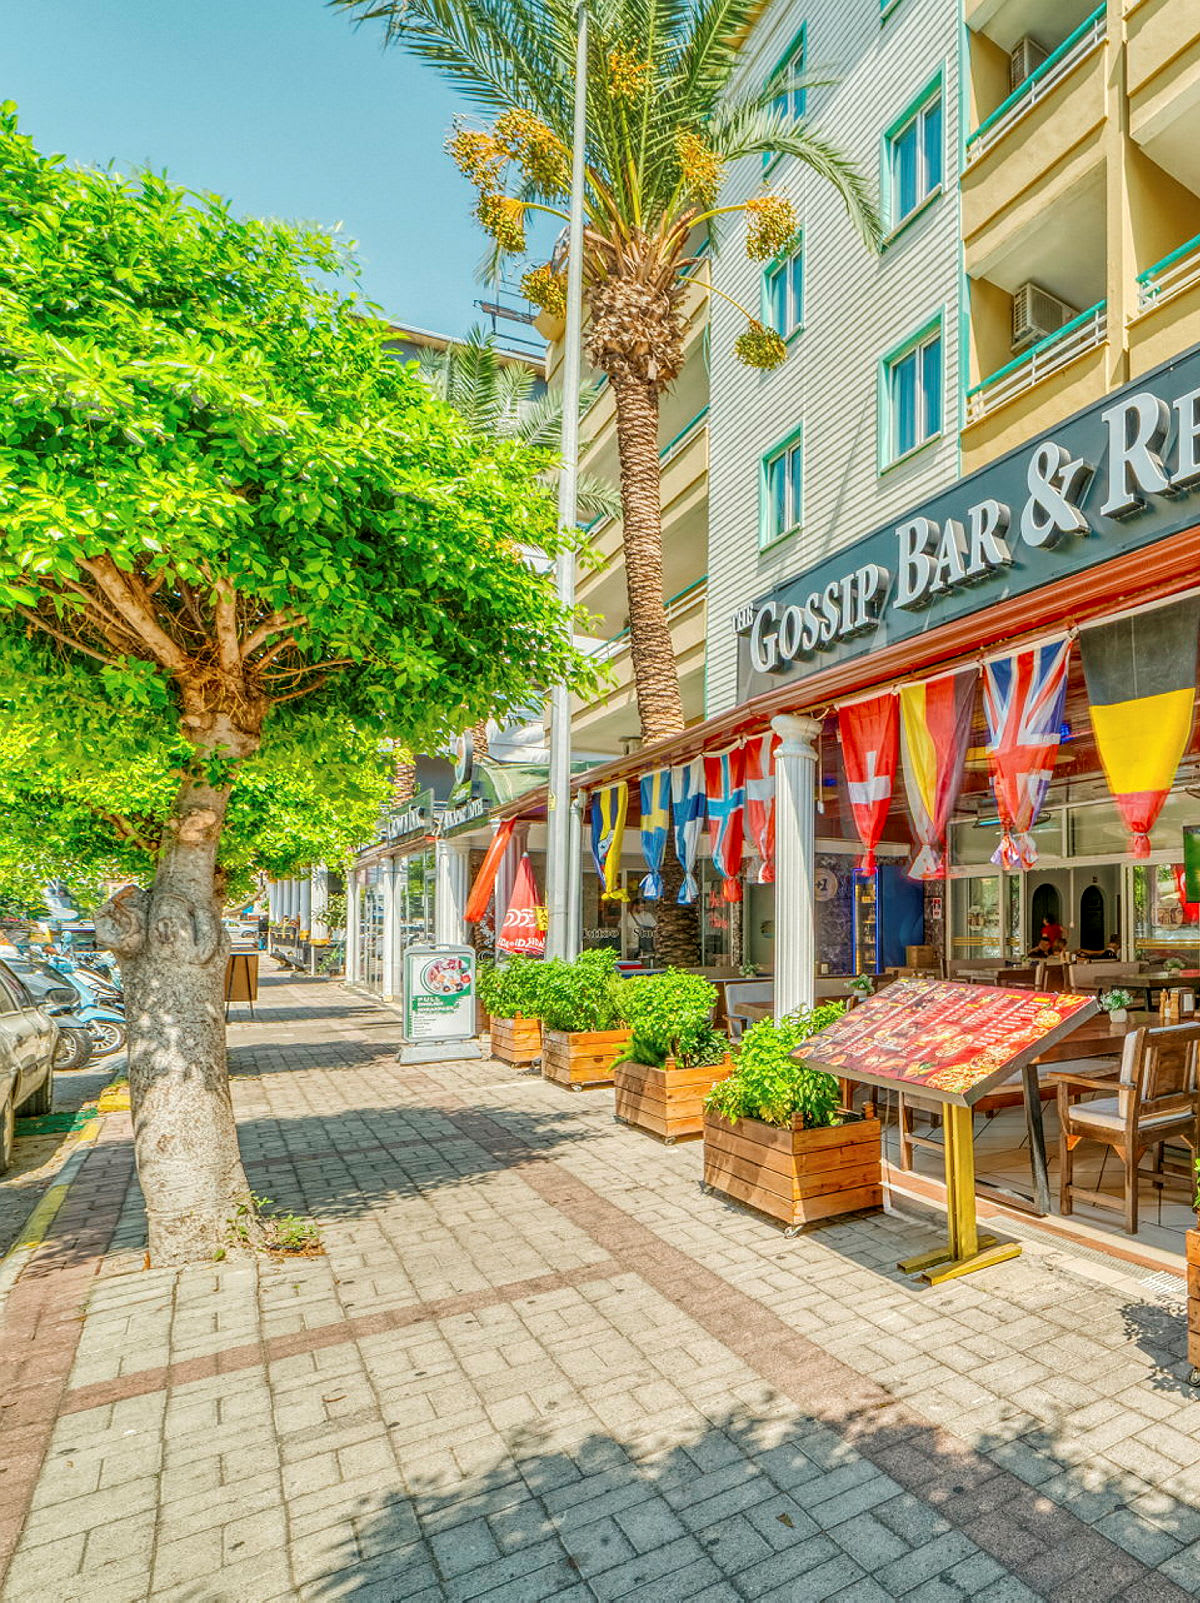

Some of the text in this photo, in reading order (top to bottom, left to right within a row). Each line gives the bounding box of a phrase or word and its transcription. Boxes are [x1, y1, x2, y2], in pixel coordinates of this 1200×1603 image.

[750, 564, 883, 674] GOSSIP
[894, 498, 1009, 608] BAR
[1020, 441, 1085, 547] &
